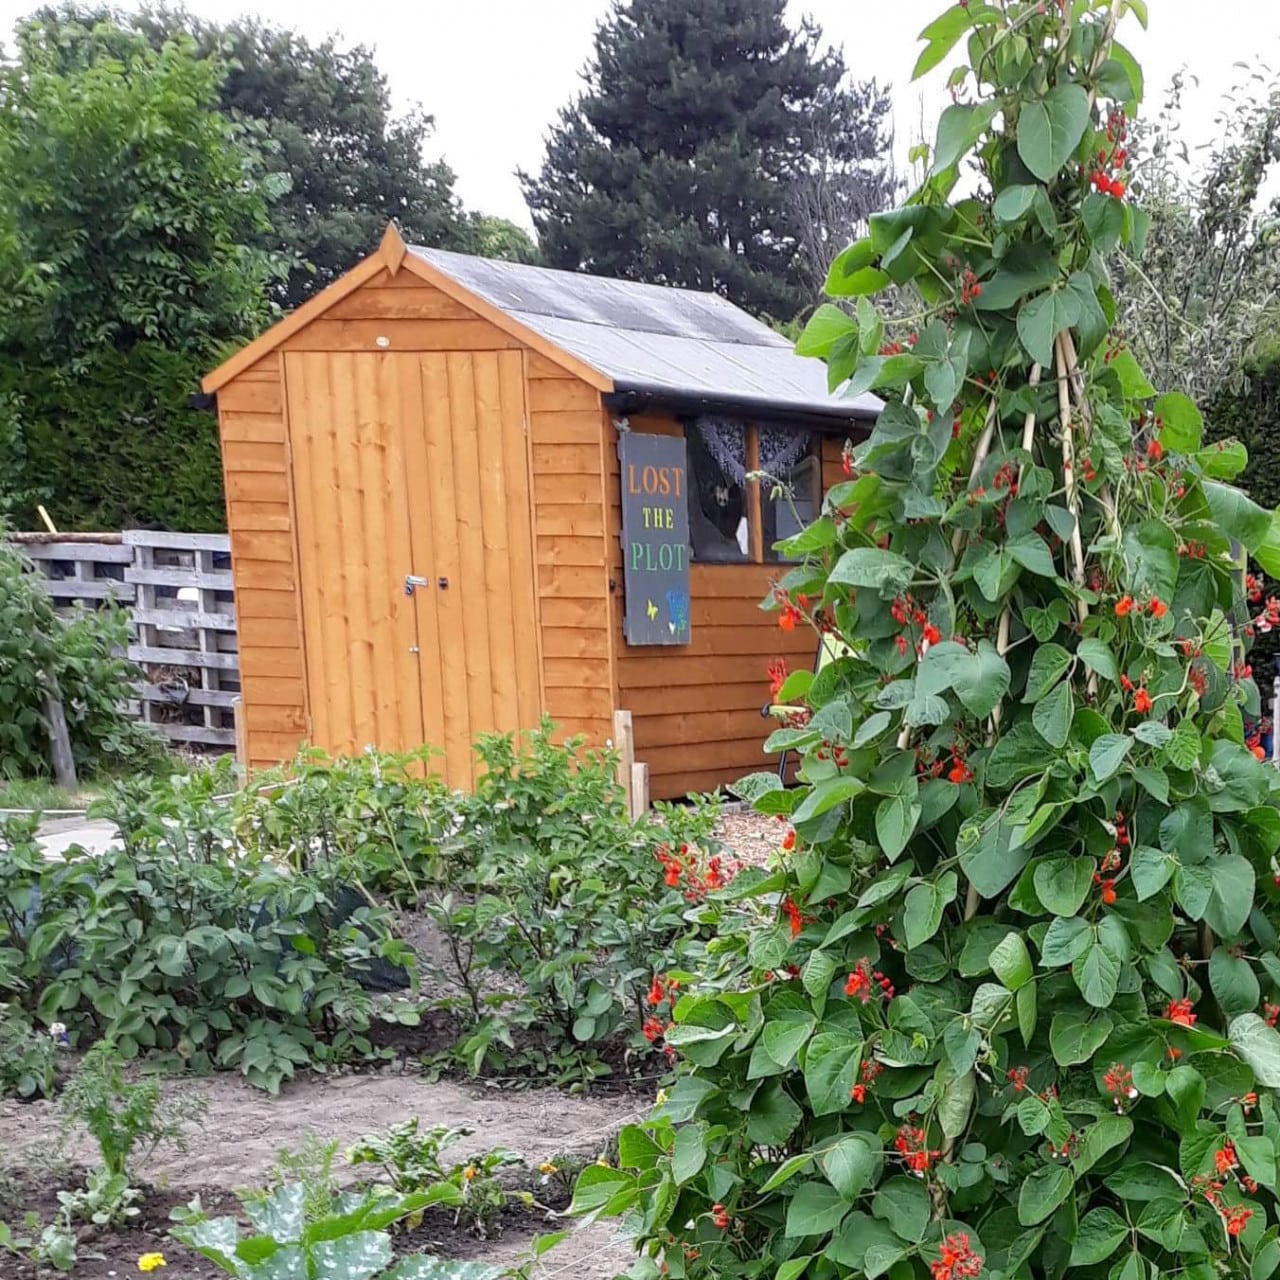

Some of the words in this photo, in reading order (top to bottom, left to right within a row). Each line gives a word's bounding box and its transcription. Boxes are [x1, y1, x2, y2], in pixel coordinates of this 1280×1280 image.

[628, 465, 684, 496] LOST
[643, 507, 674, 529] THE
[631, 543, 685, 571] PLOT
